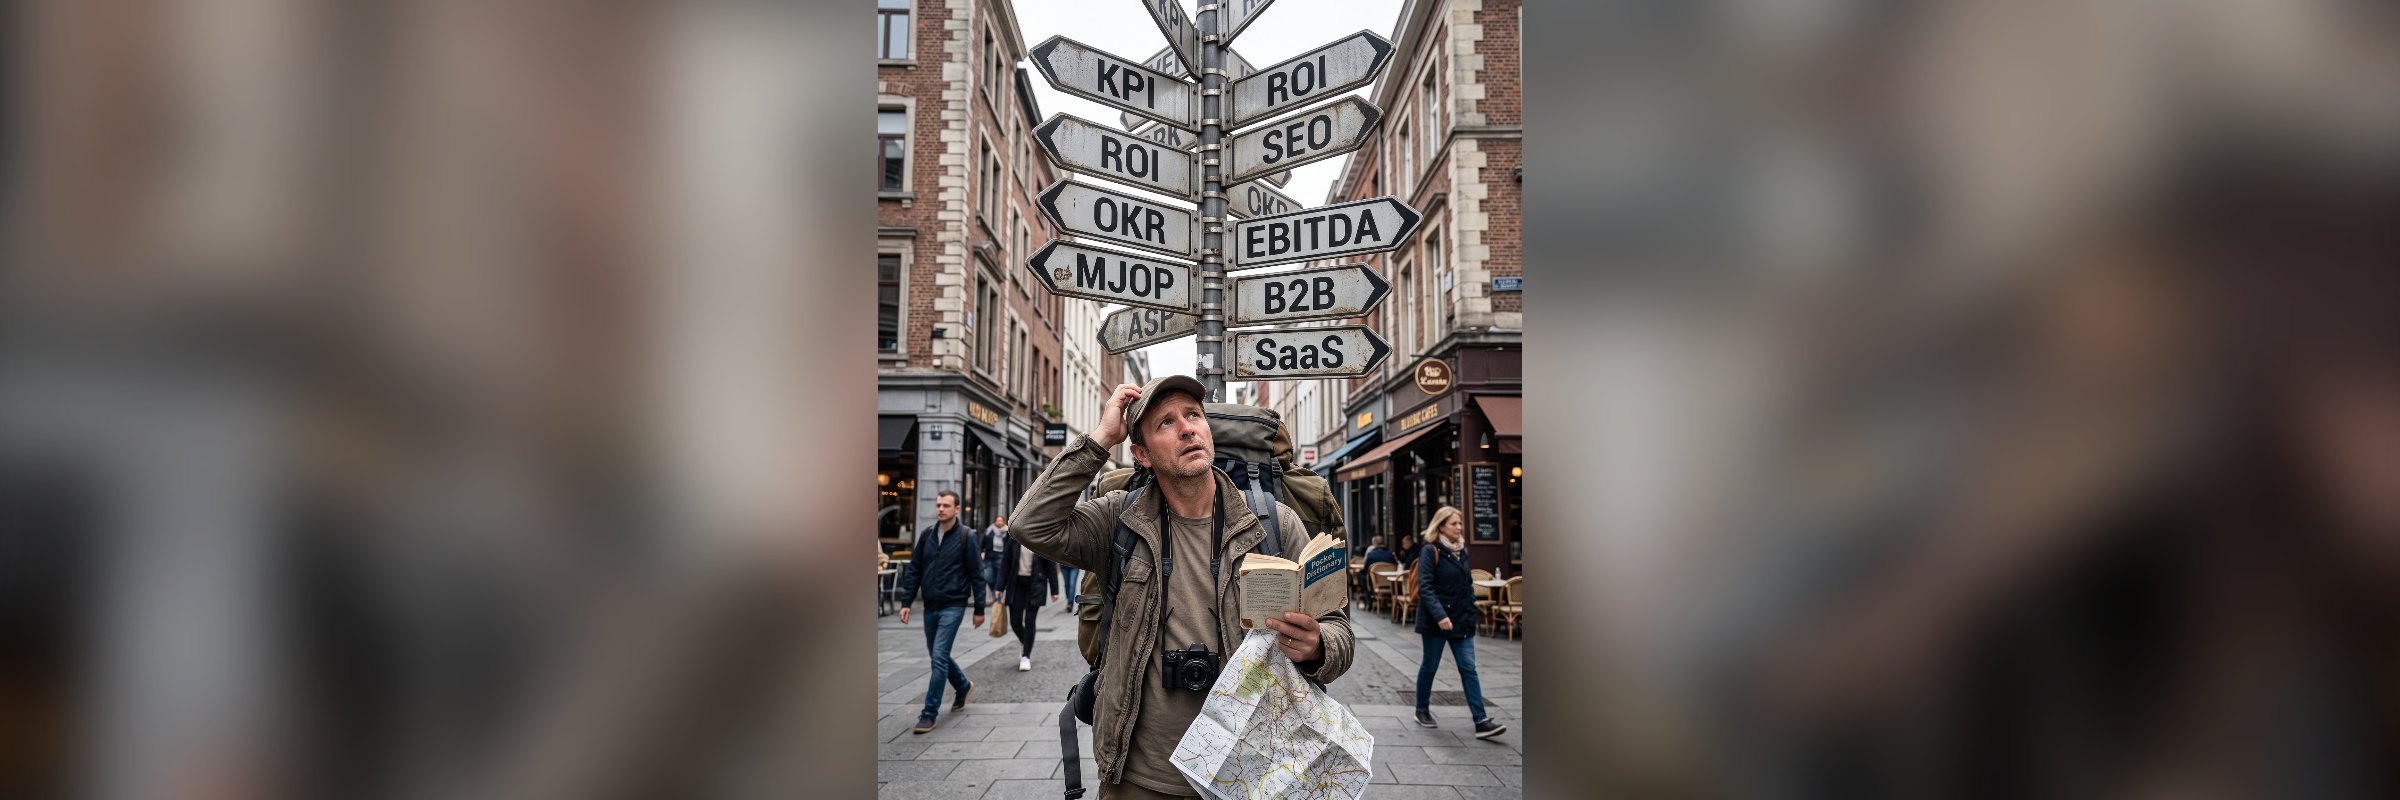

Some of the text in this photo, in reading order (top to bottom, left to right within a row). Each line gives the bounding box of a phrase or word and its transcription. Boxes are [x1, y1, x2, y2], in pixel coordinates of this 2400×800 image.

[1097, 58, 1154, 109] KPI
[1267, 55, 1326, 107] ROI
[1101, 135, 1158, 182] ROI
[1263, 115, 1331, 164] SEO
[1094, 197, 1165, 244] OKR
[1247, 209, 1381, 258] EBITDA
[1076, 253, 1174, 299] MJOP
[1264, 277, 1335, 314] B2B
[1128, 309, 1174, 341] ASP
[1256, 335, 1344, 370] SaaS
[1311, 552, 1335, 569] Pocket
